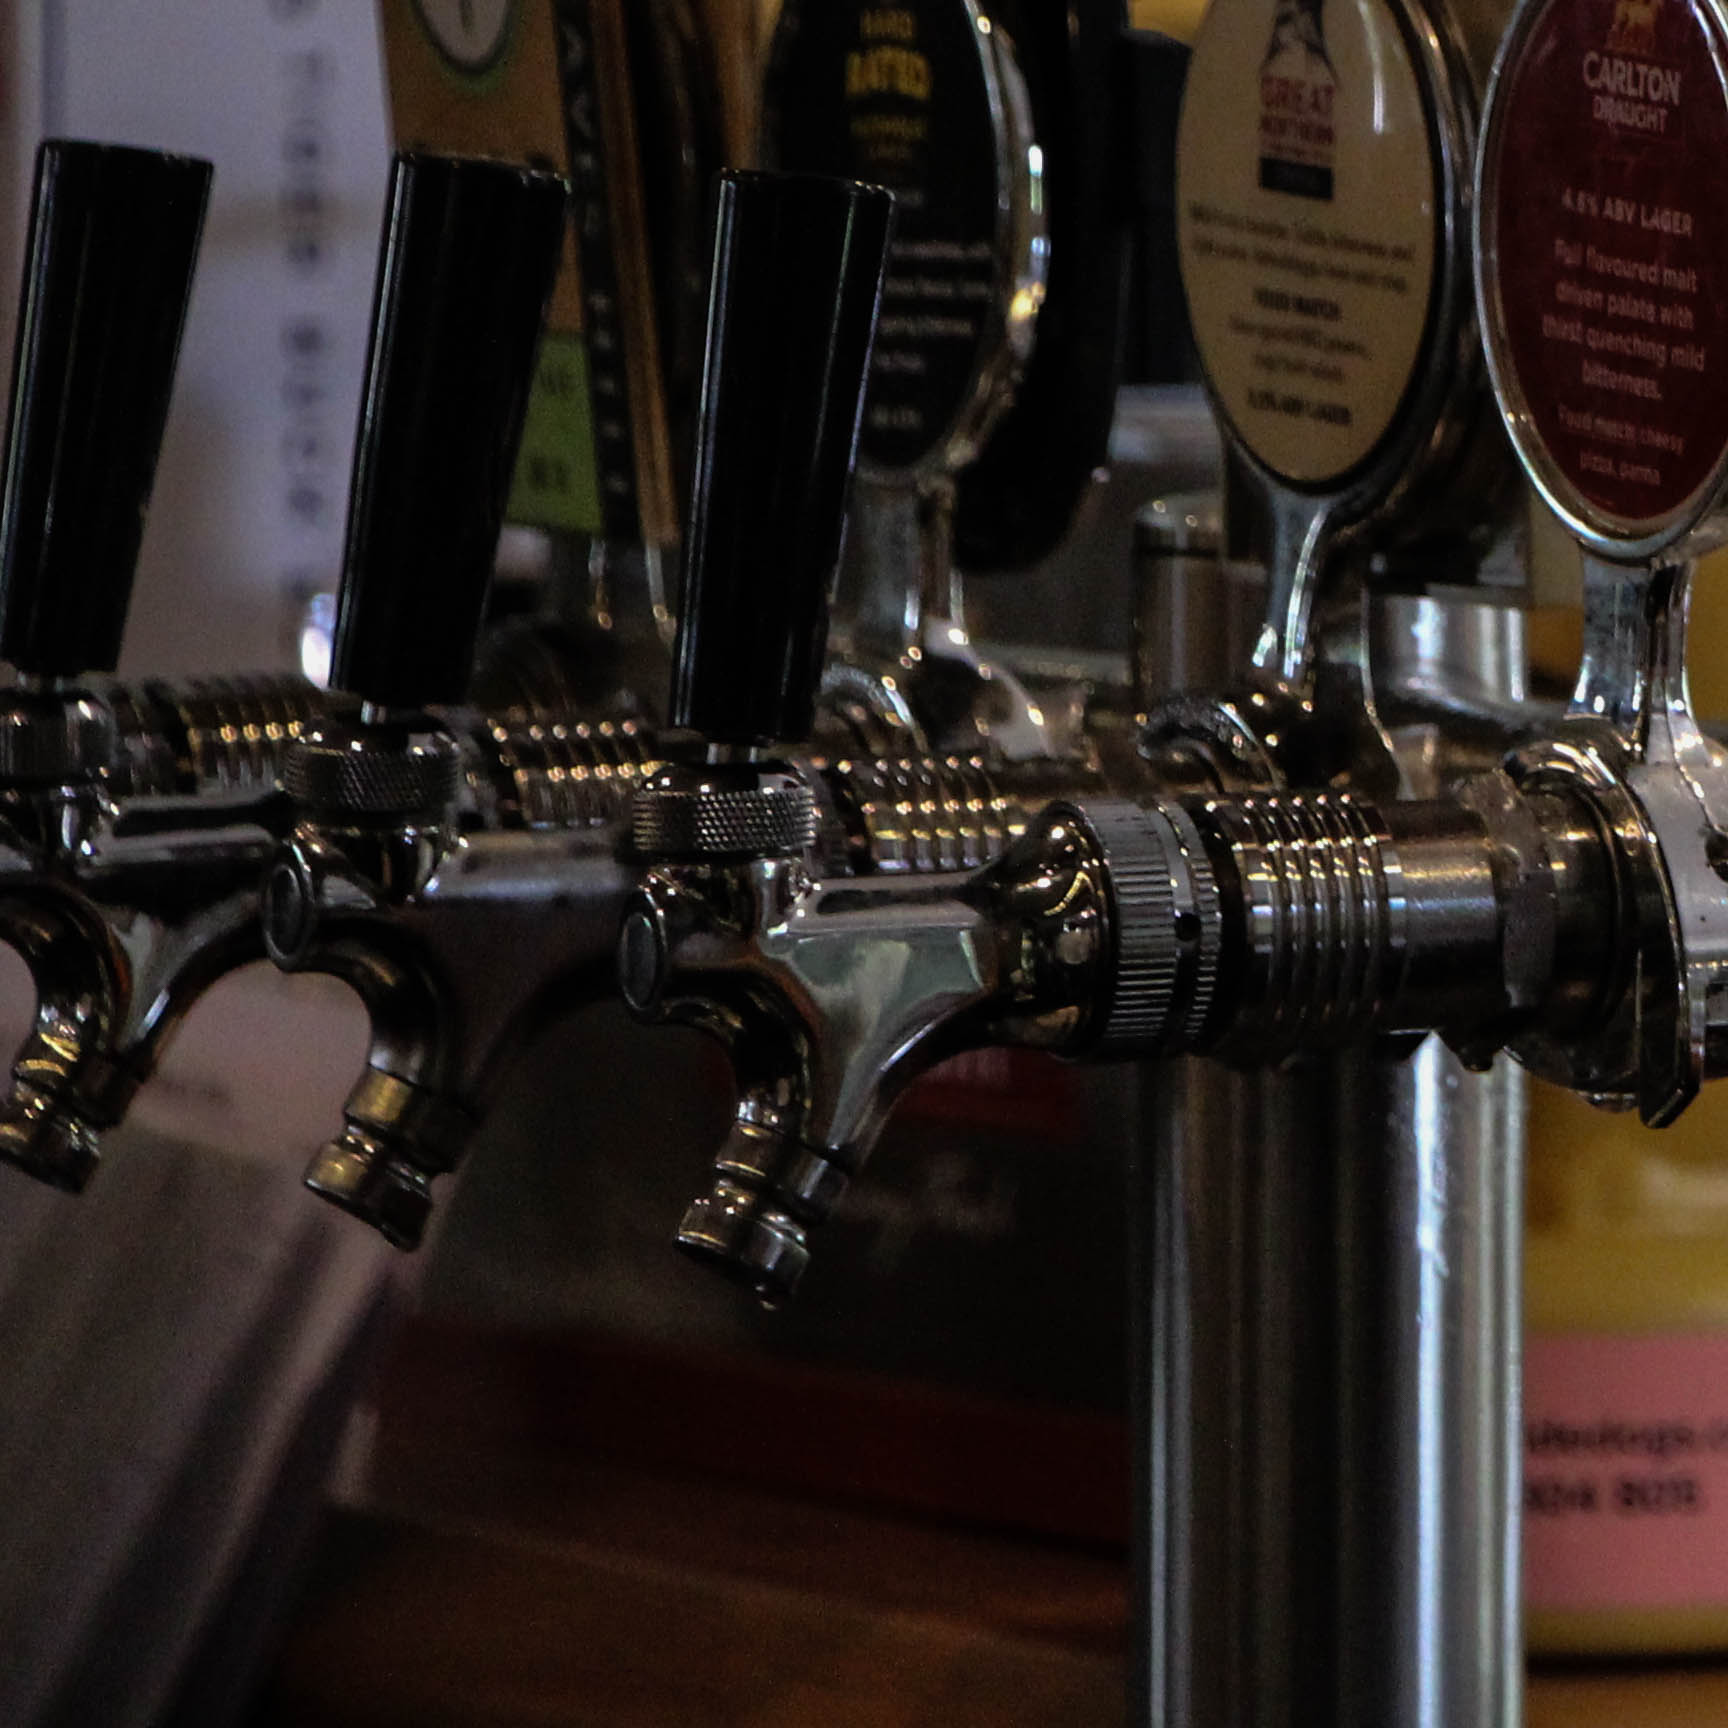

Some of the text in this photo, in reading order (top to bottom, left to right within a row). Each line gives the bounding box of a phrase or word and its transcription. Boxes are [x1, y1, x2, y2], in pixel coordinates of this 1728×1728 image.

[1582, 50, 1681, 106] CARLTON
[1592, 94, 1668, 134] DRAUGHT
[1603, 195, 1637, 225] ABV
[1640, 203, 1694, 238] LAGER
[1586, 245, 1659, 285] flavoured
[1663, 266, 1698, 294] malt
[1555, 278, 1695, 331] driven palate with
[1541, 313, 1706, 372] thirst quenching mild
[1582, 359, 1663, 401] bitterness.
